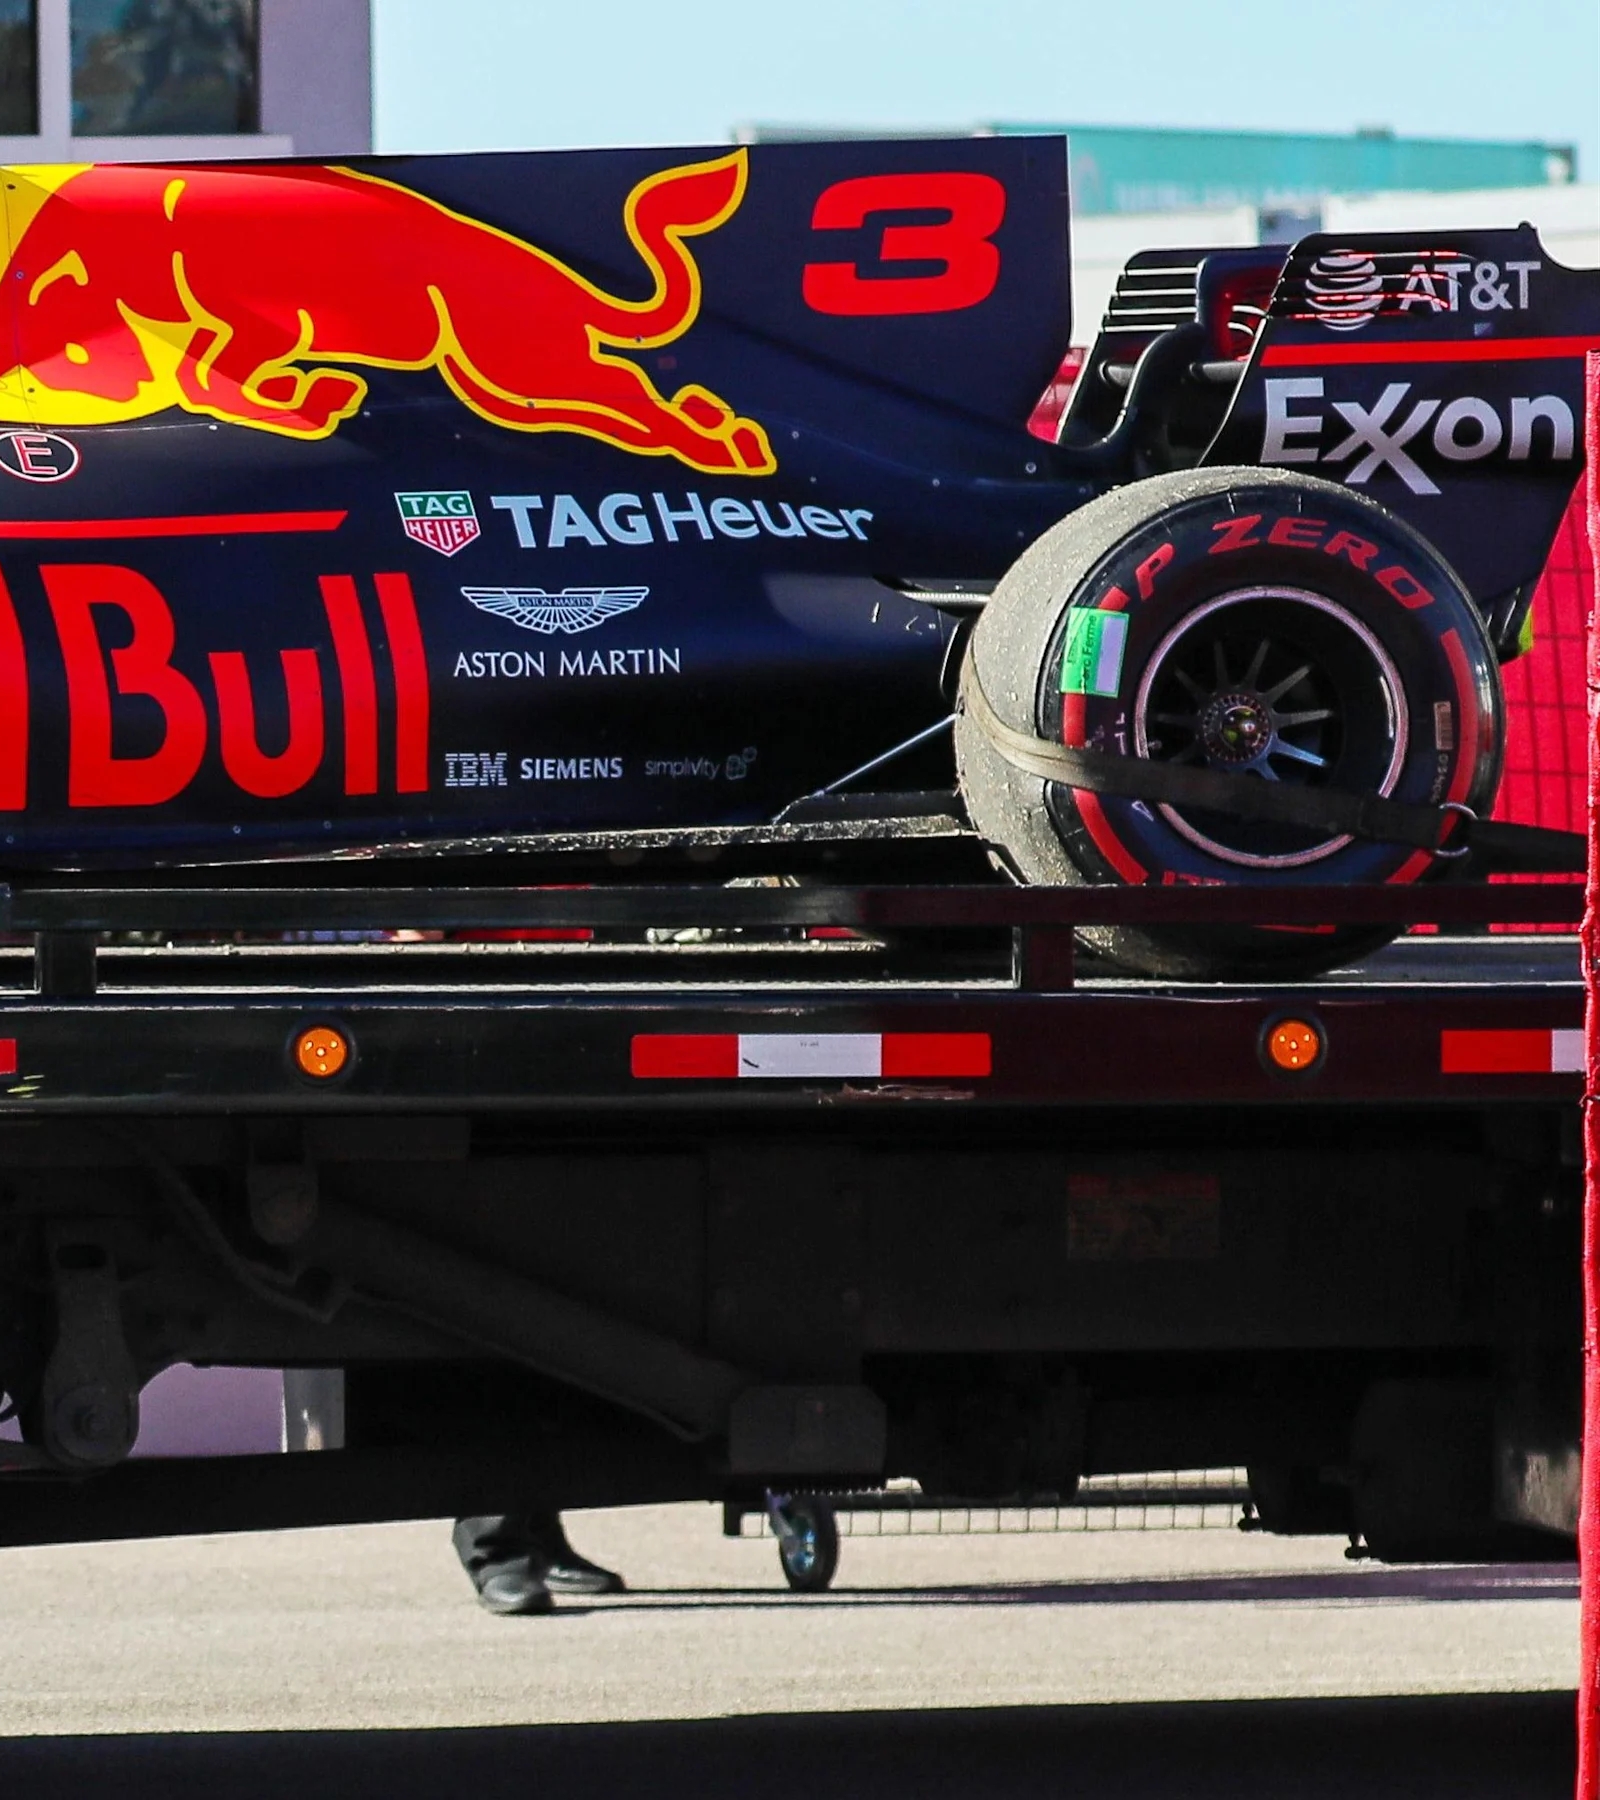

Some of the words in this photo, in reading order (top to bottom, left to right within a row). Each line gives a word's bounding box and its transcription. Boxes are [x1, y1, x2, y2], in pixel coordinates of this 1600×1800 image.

[802, 170, 1006, 315] 3
[1399, 260, 1540, 312] AT&T
[10, 435, 58, 475] E
[403, 493, 468, 516] TAG
[407, 518, 476, 553] HEUER
[1136, 542, 1174, 599] P
[1207, 513, 1435, 610] ZERO
[519, 597, 553, 607] ASTON
[553, 597, 592, 607] MARTIN
[453, 650, 545, 678] ASTON
[559, 648, 681, 676] MARTIN
[444, 752, 508, 787] IBM
[520, 757, 623, 780] SIEMENS
